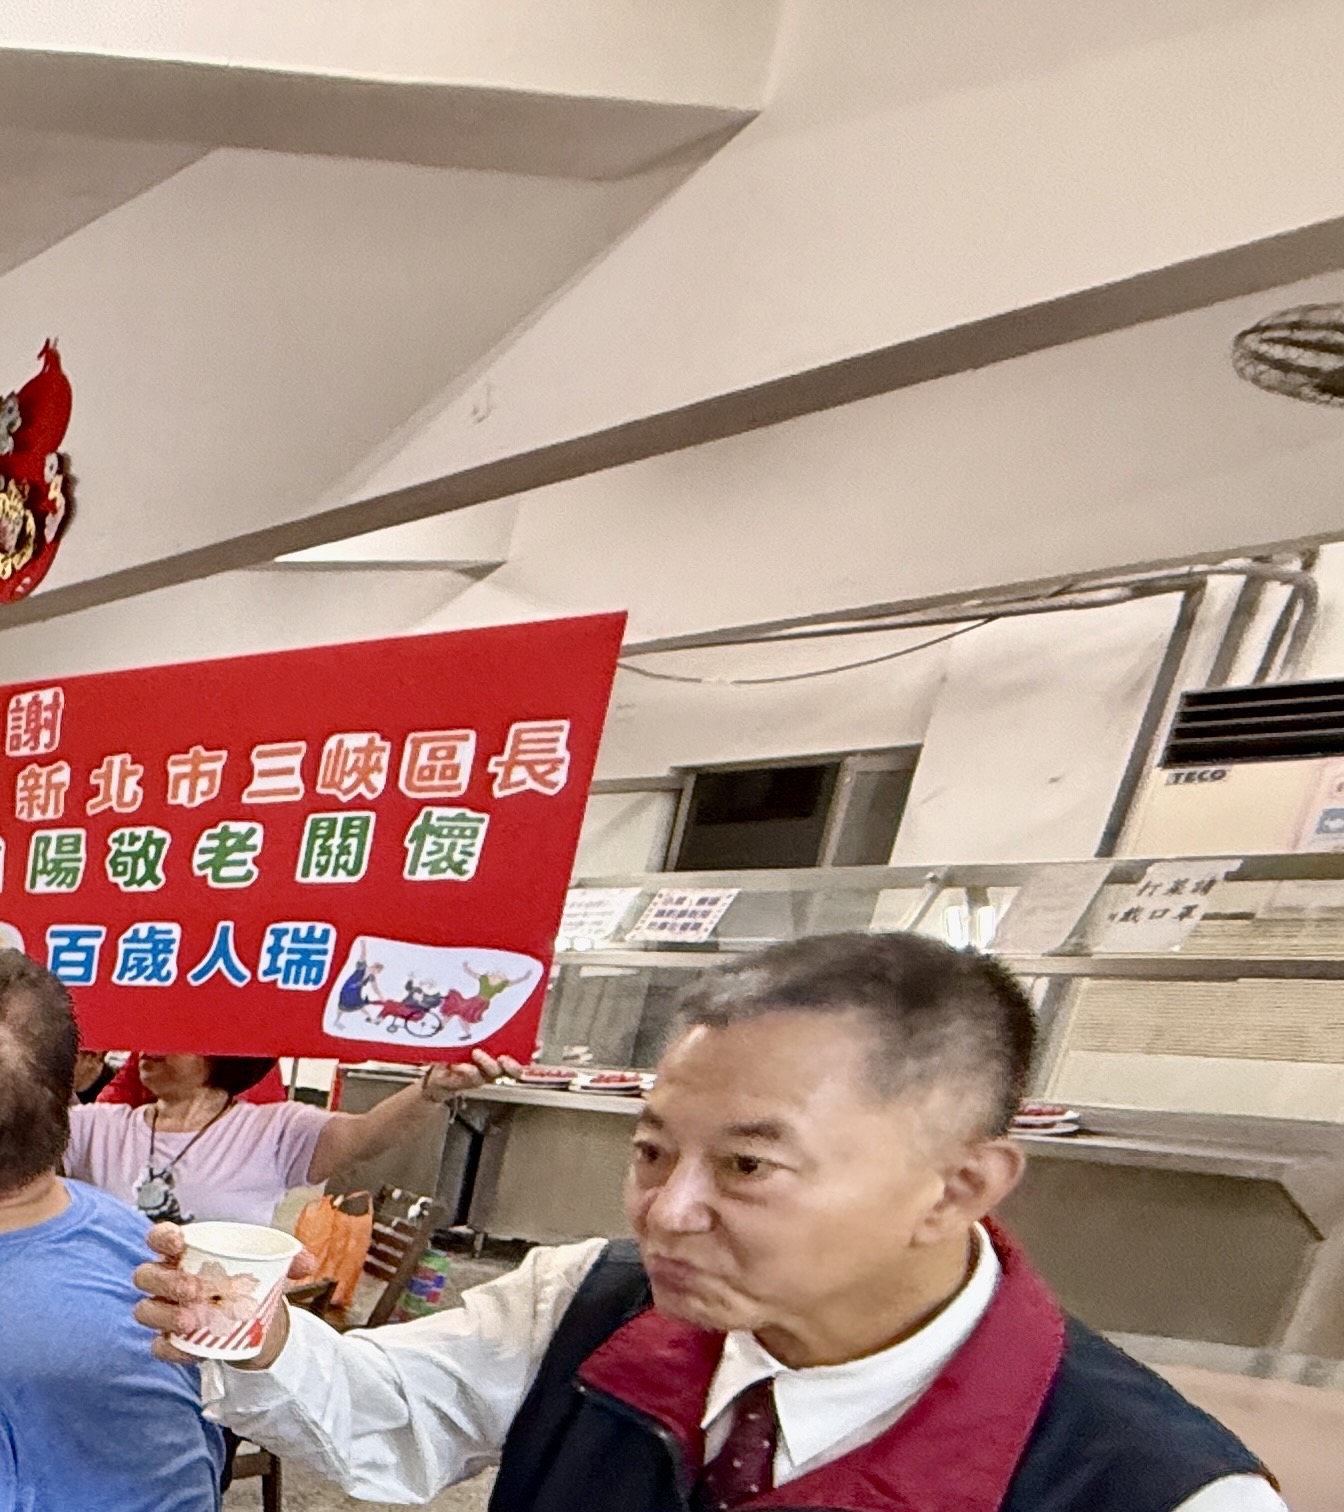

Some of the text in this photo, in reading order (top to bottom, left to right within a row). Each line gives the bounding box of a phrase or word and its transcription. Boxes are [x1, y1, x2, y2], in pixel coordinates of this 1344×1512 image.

[19, 722, 568, 819] 新北市三峽區長
[1173, 769, 1227, 784] TECO
[48, 923, 332, 986] 百歲人瑞
